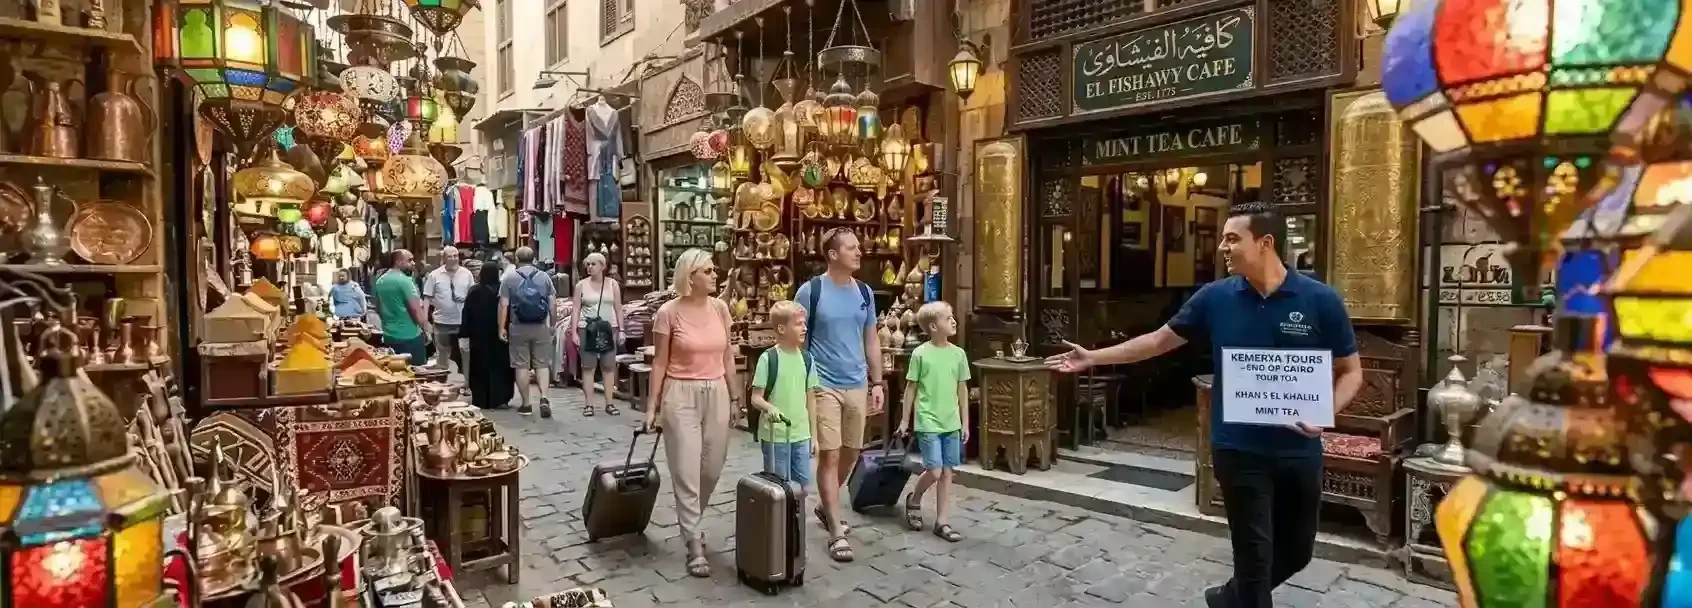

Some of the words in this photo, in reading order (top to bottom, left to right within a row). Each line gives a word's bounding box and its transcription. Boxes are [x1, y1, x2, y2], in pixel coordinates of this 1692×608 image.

[1086, 81, 1105, 98] EL
[1108, 66, 1184, 94] FISHAWY
[1186, 57, 1236, 82] CAFE
[1095, 136, 1143, 159] MINT
[1146, 132, 1184, 153] TEA
[1187, 124, 1243, 149] CAFE
[1284, 354, 1323, 364] TOURS
[1283, 365, 1314, 373] CAIRO
[1255, 374, 1279, 382] TOUR
[1235, 391, 1261, 399] KHAN
[1270, 392, 1281, 400] EL
[1283, 393, 1320, 402] KHALILI
[1255, 407, 1279, 415] MINT
[1281, 408, 1300, 416] TEA
